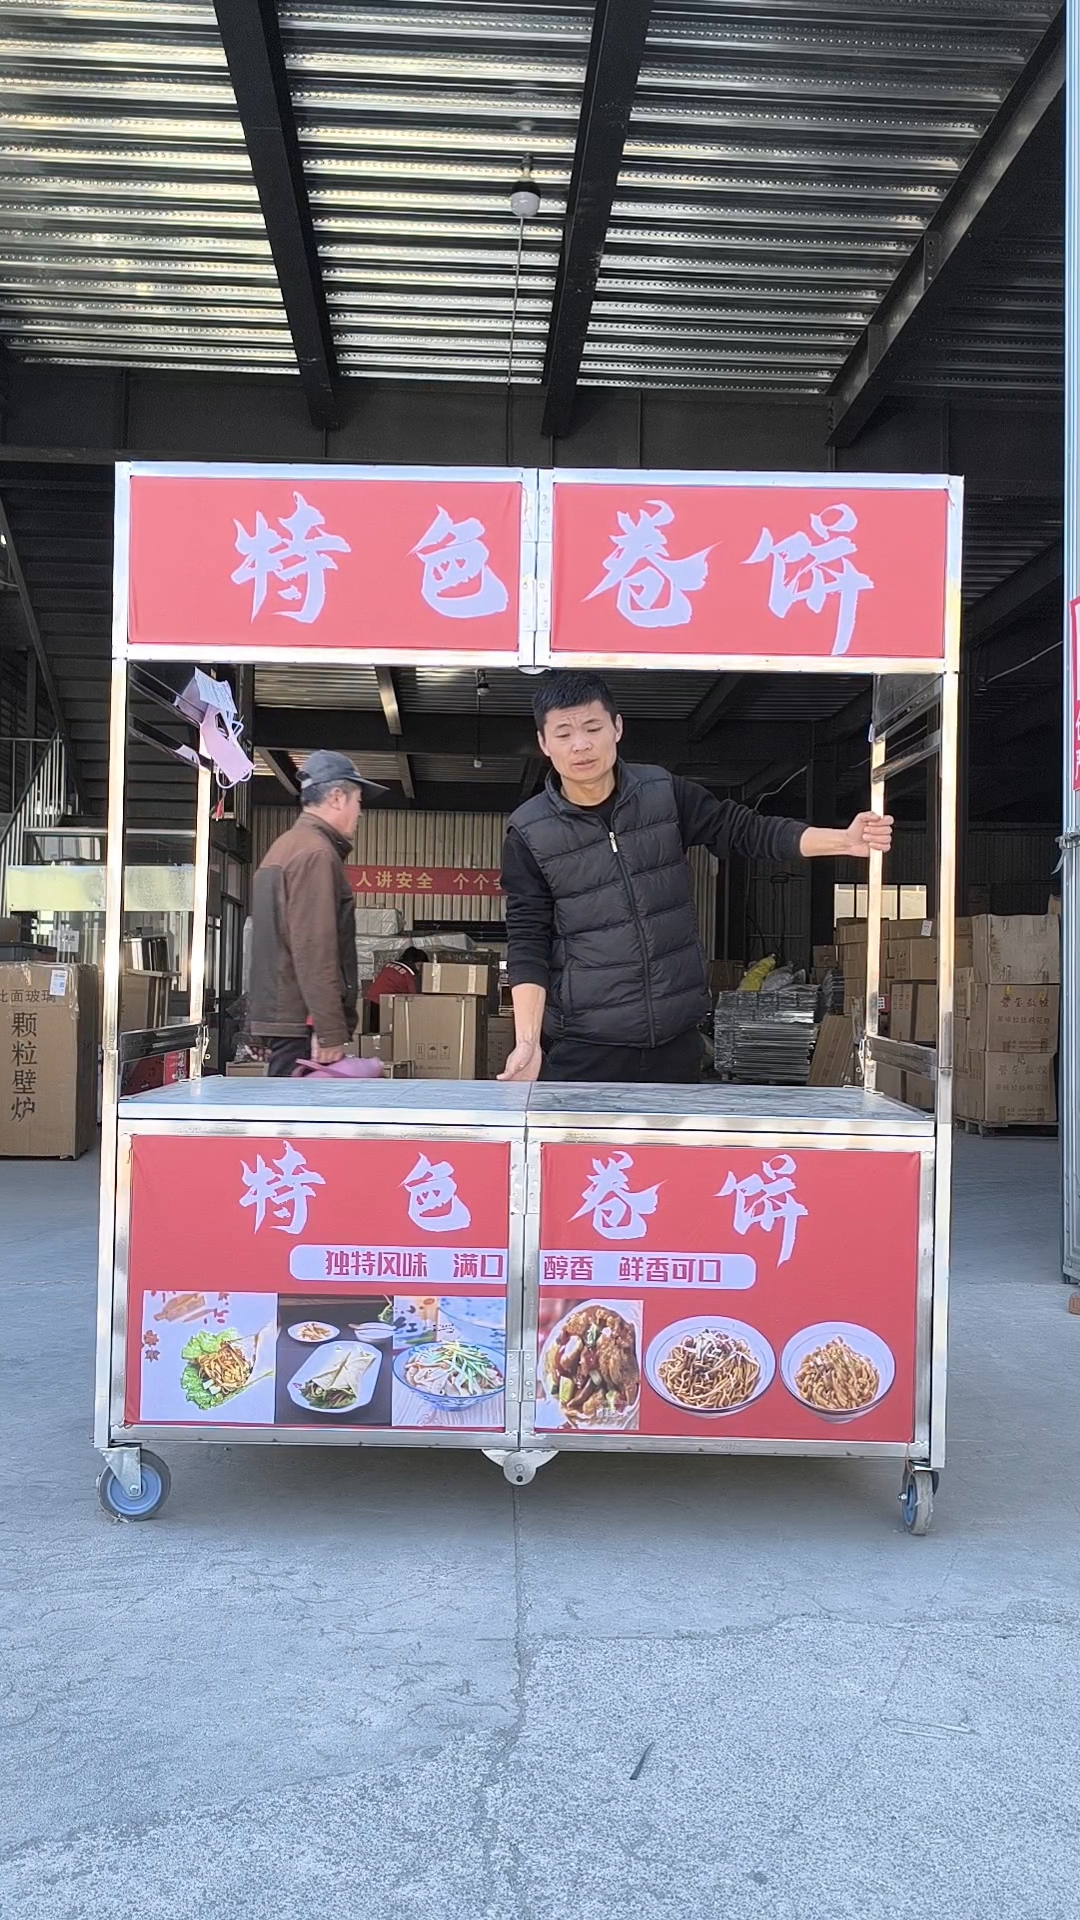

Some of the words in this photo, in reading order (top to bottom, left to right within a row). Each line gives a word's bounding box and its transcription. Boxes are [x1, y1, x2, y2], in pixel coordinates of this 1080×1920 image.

[356, 871, 434, 889] 人讲安全
[11, 1011, 38, 1122] 颗粒壁炉
[325, 1251, 427, 1277] 独特风味
[619, 1256, 721, 1283] 鲜香可口
